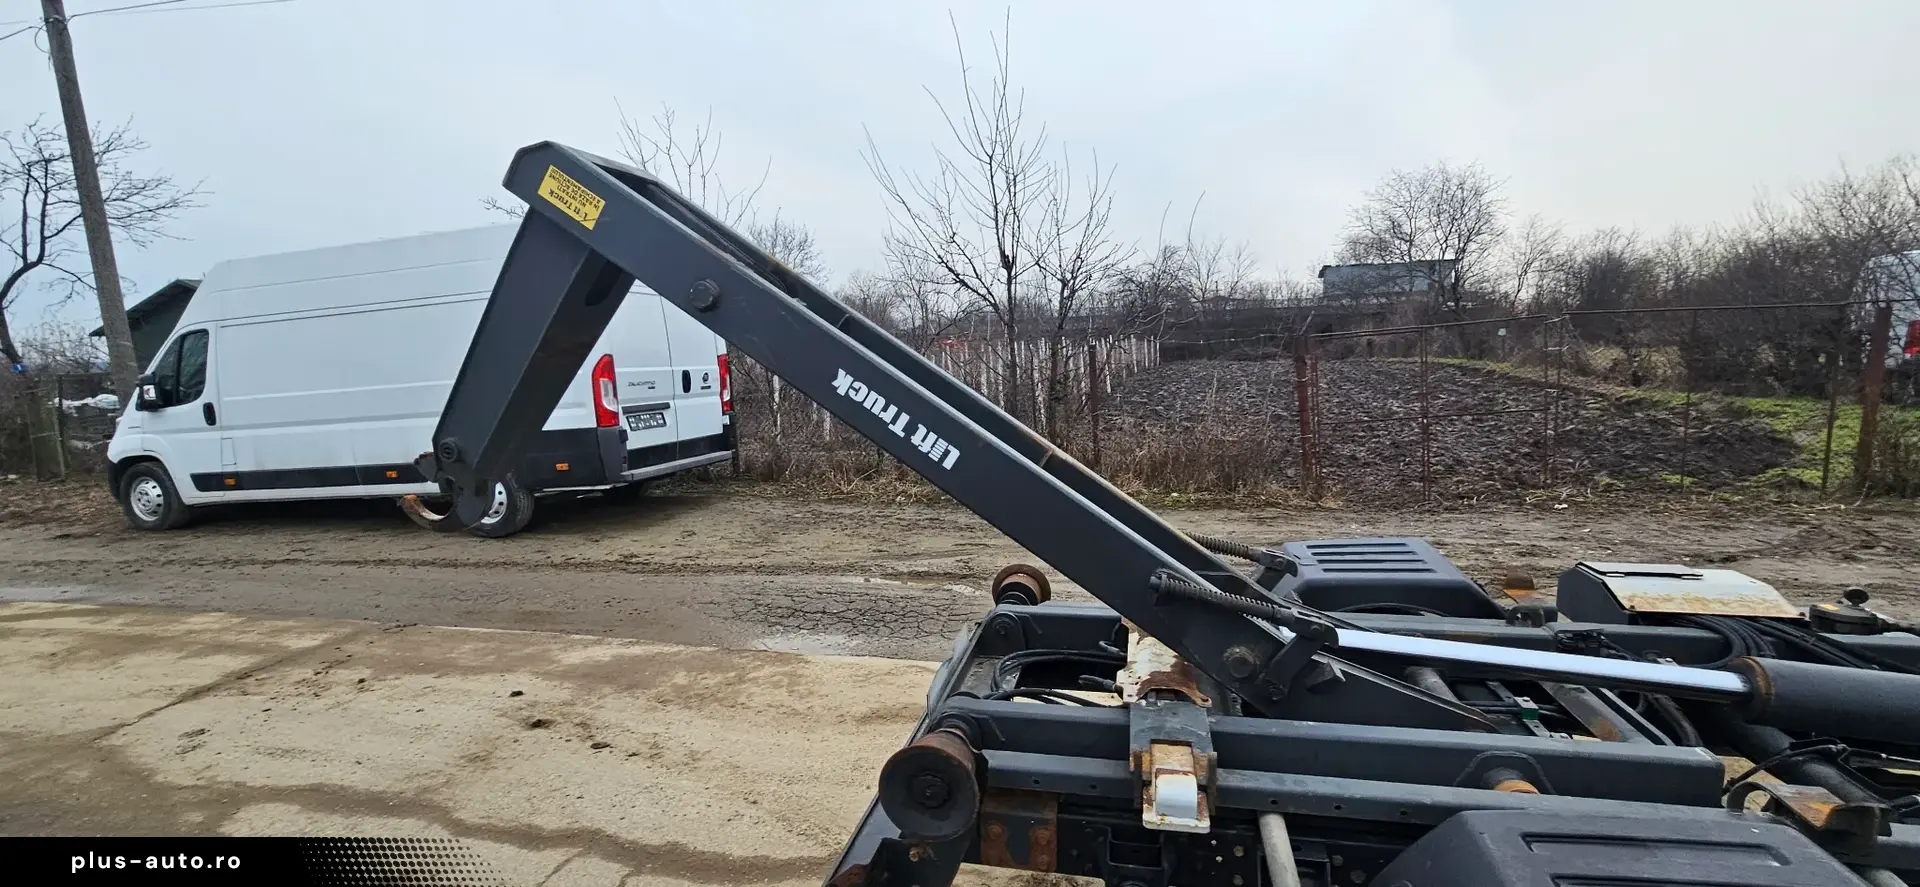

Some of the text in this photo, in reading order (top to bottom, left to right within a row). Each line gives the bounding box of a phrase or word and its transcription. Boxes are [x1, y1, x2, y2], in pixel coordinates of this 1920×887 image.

[548, 188, 573, 210] Truck
[577, 198, 587, 208] NU
[578, 193, 593, 206] RAZA
[831, 368, 960, 471] Lift Truck
